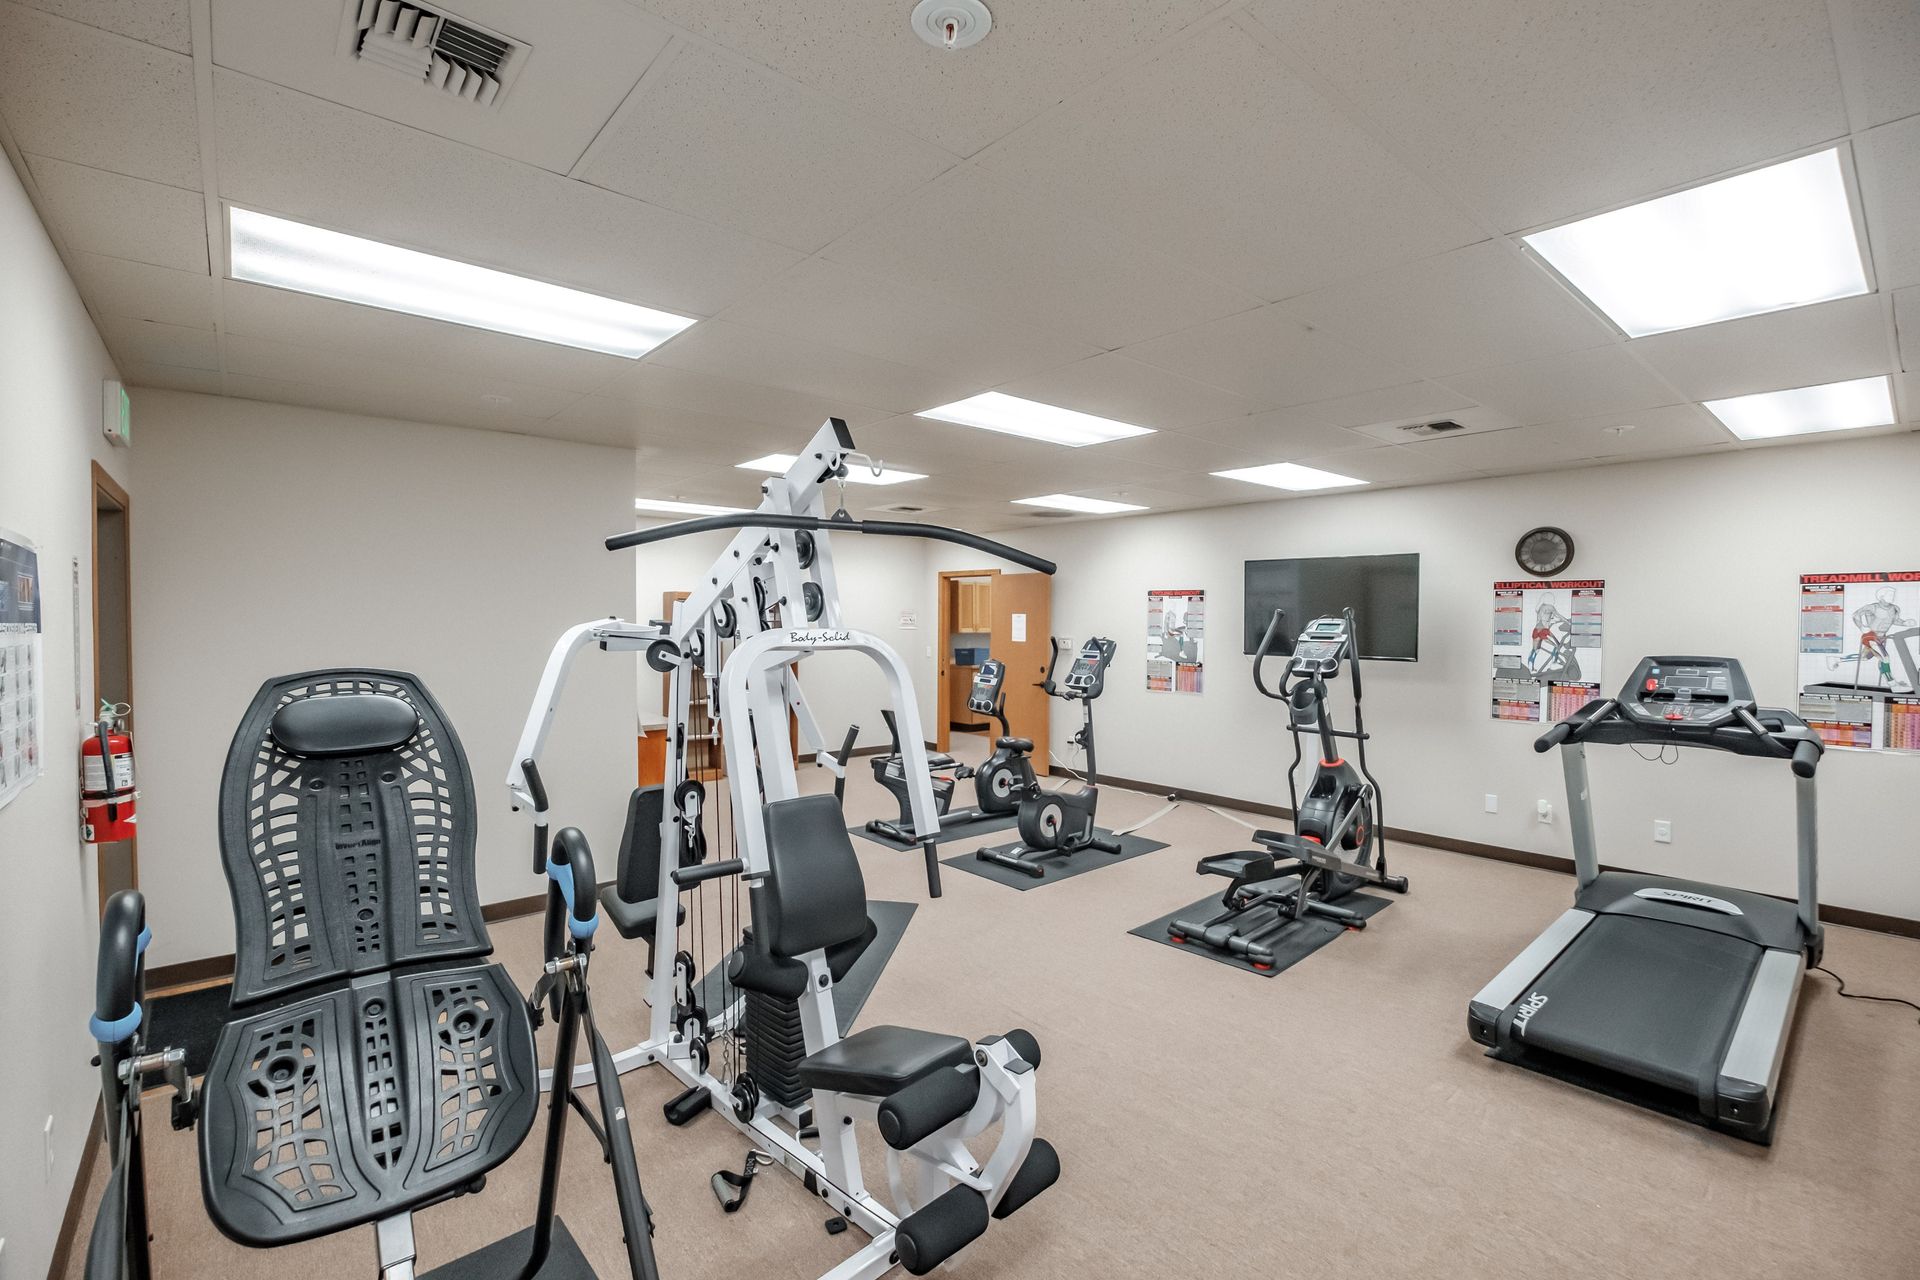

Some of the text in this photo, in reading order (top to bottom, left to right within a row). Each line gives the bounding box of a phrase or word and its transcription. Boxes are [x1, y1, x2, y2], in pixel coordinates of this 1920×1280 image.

[1802, 574, 1884, 583] TREADMILL
[790, 631, 850, 645] Body-Solid
[1663, 891, 1713, 903] SPIRIT
[1512, 991, 1549, 1037] SPIRIT
